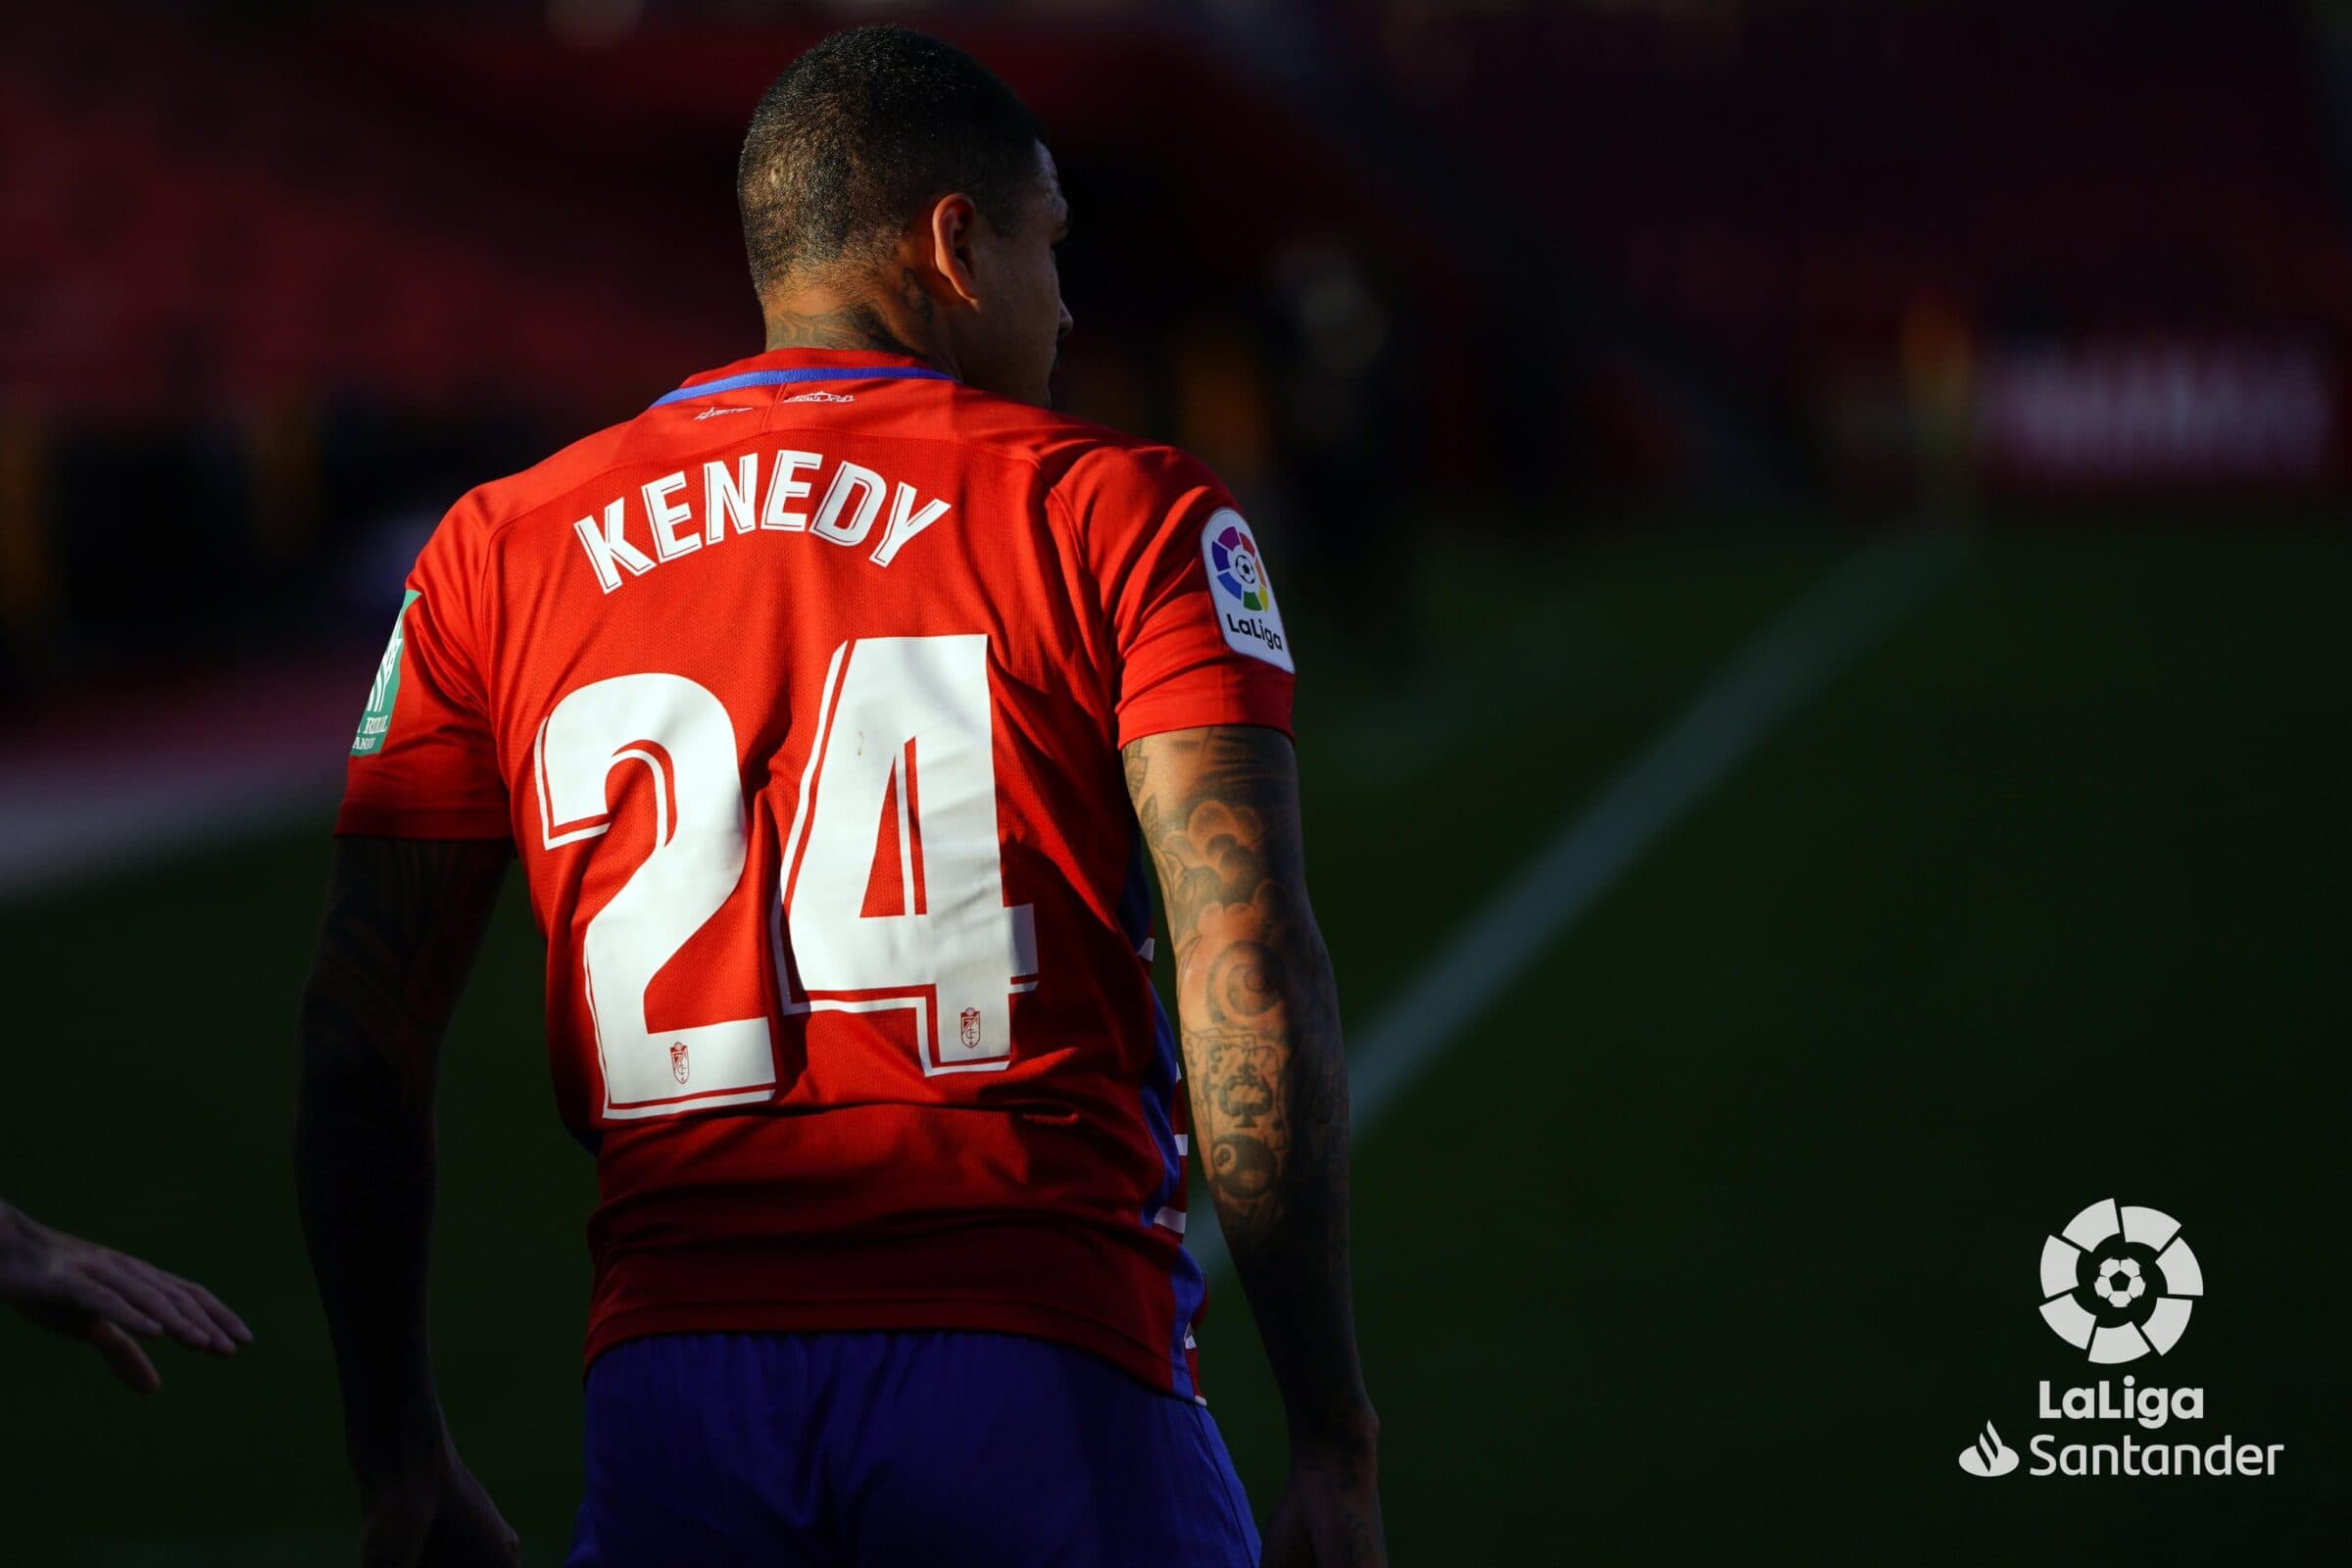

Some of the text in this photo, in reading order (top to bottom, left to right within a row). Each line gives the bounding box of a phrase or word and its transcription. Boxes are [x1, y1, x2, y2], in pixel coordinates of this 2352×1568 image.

[573, 450, 951, 594] KENEDY
[1226, 612, 1284, 652] LaLiga
[534, 634, 1039, 1119] 24
